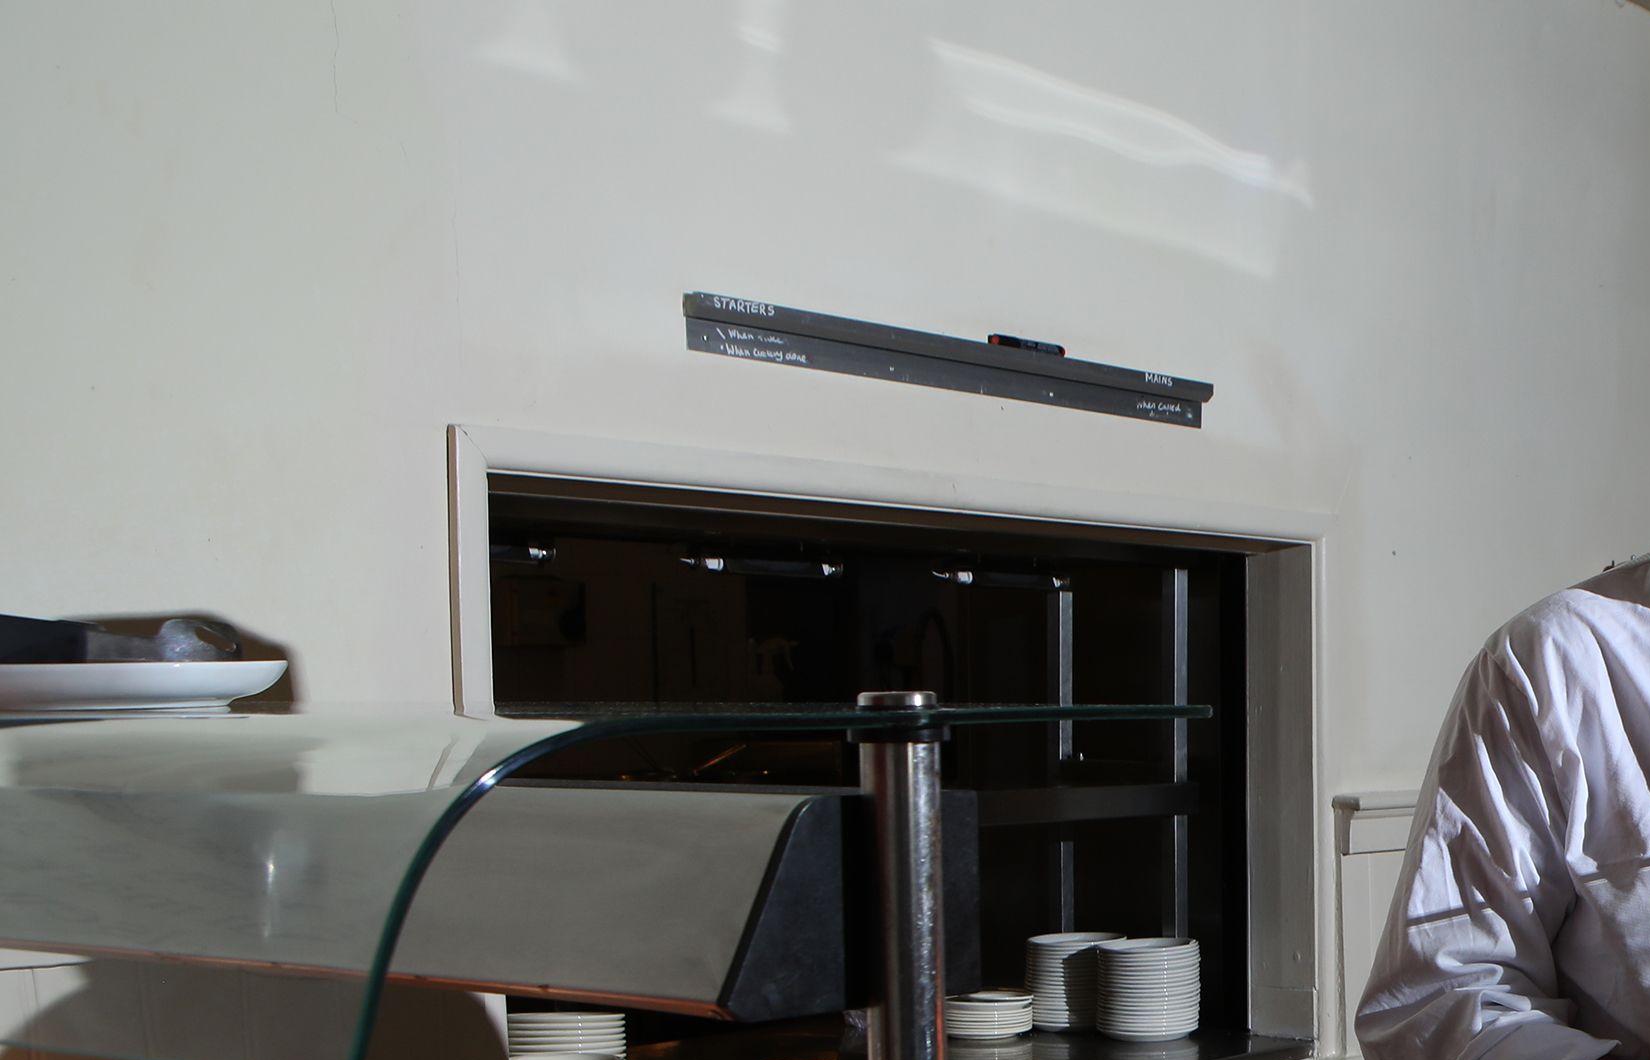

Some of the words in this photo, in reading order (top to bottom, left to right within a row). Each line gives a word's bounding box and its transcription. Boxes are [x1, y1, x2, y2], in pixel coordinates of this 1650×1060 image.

[713, 295, 776, 317] STARTERS
[725, 343, 752, 357] When
[1144, 372, 1173, 387] MAINS
